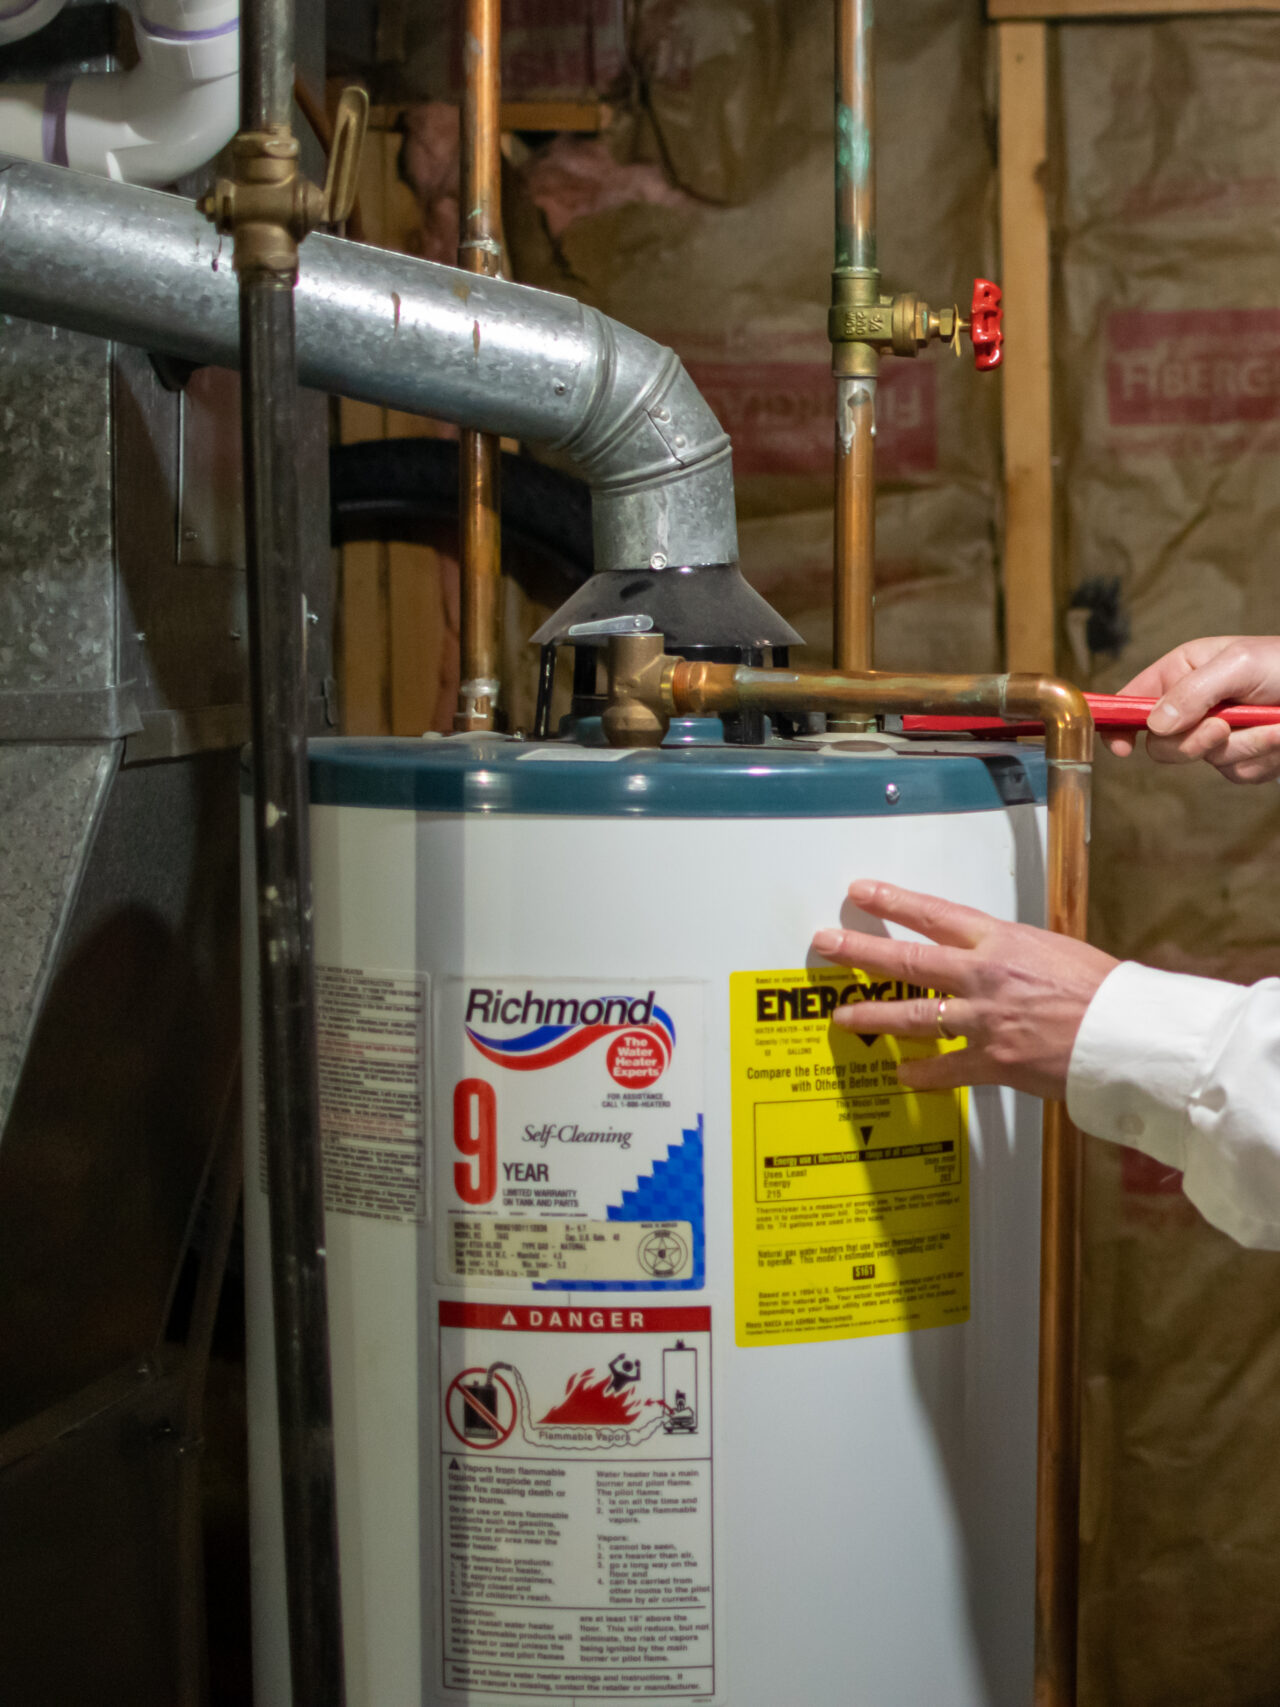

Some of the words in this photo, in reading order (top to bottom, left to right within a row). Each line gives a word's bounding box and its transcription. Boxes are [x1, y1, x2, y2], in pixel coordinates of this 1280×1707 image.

[465, 988, 656, 1026] Richmond
[624, 1037, 648, 1047] The
[617, 1047, 654, 1056] Water
[615, 1057, 657, 1067] Heater
[613, 1067, 660, 1079] Experts
[747, 1067, 791, 1080] Compare
[794, 1066, 810, 1077] the
[814, 1064, 847, 1079] Energy
[850, 1061, 867, 1074] Use
[870, 1060, 879, 1073] of
[881, 1060, 898, 1071] this
[791, 1081, 811, 1093] with
[815, 1078, 846, 1091] Others
[849, 1076, 879, 1089] Before
[881, 1074, 898, 1086] You
[453, 1078, 497, 1205] 9
[521, 1123, 634, 1149] Self-Cleaning
[502, 1162, 549, 1183] YEAR
[764, 1181, 791, 1189] Energy
[502, 1188, 532, 1198] LIMITED
[533, 1189, 577, 1199] WARRANTY
[515, 1199, 535, 1207] TANK
[536, 1199, 552, 1208] AND
[553, 1199, 579, 1208] PARTS
[529, 1310, 645, 1328] DANGER
[539, 1430, 593, 1442] Flammable
[596, 1431, 632, 1443] Vapors
[462, 1463, 492, 1473] Vapors
[495, 1465, 515, 1474] from
[518, 1467, 566, 1476] flammable
